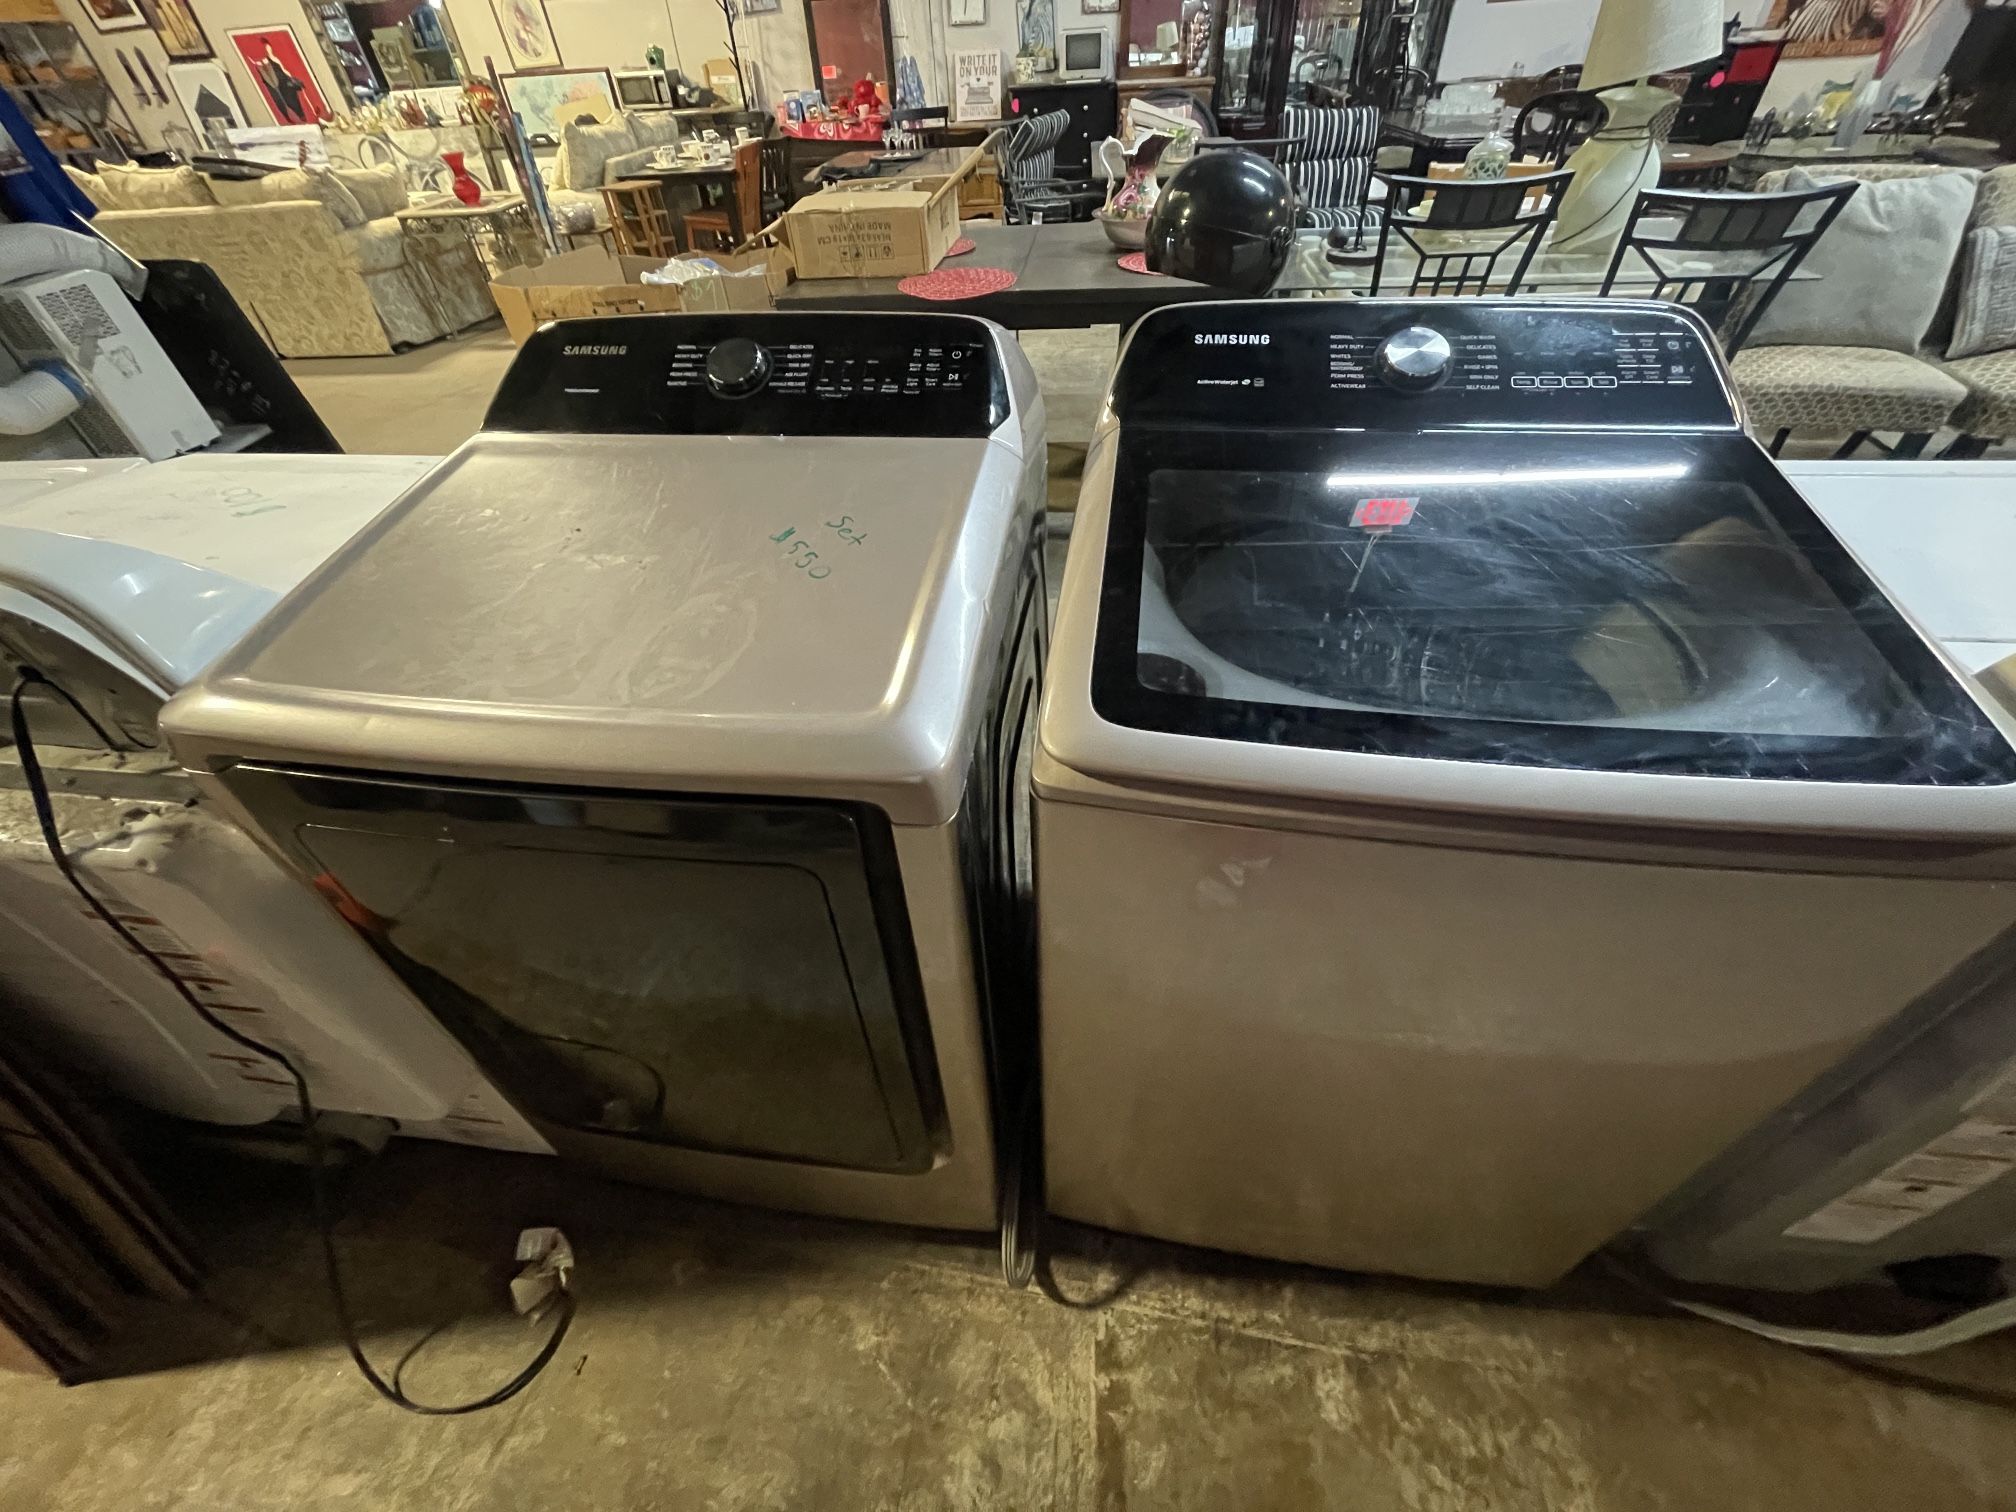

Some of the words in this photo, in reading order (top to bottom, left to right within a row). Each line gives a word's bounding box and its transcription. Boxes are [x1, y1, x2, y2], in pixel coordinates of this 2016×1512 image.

[959, 55, 987, 66] WRITE
[988, 54, 997, 64] IT
[959, 67, 972, 77] ON
[974, 65, 998, 76] YOUR
[1194, 334, 1271, 345] SAMSUNG
[562, 345, 628, 355] SAMSUNG
[825, 515, 868, 546] Set
